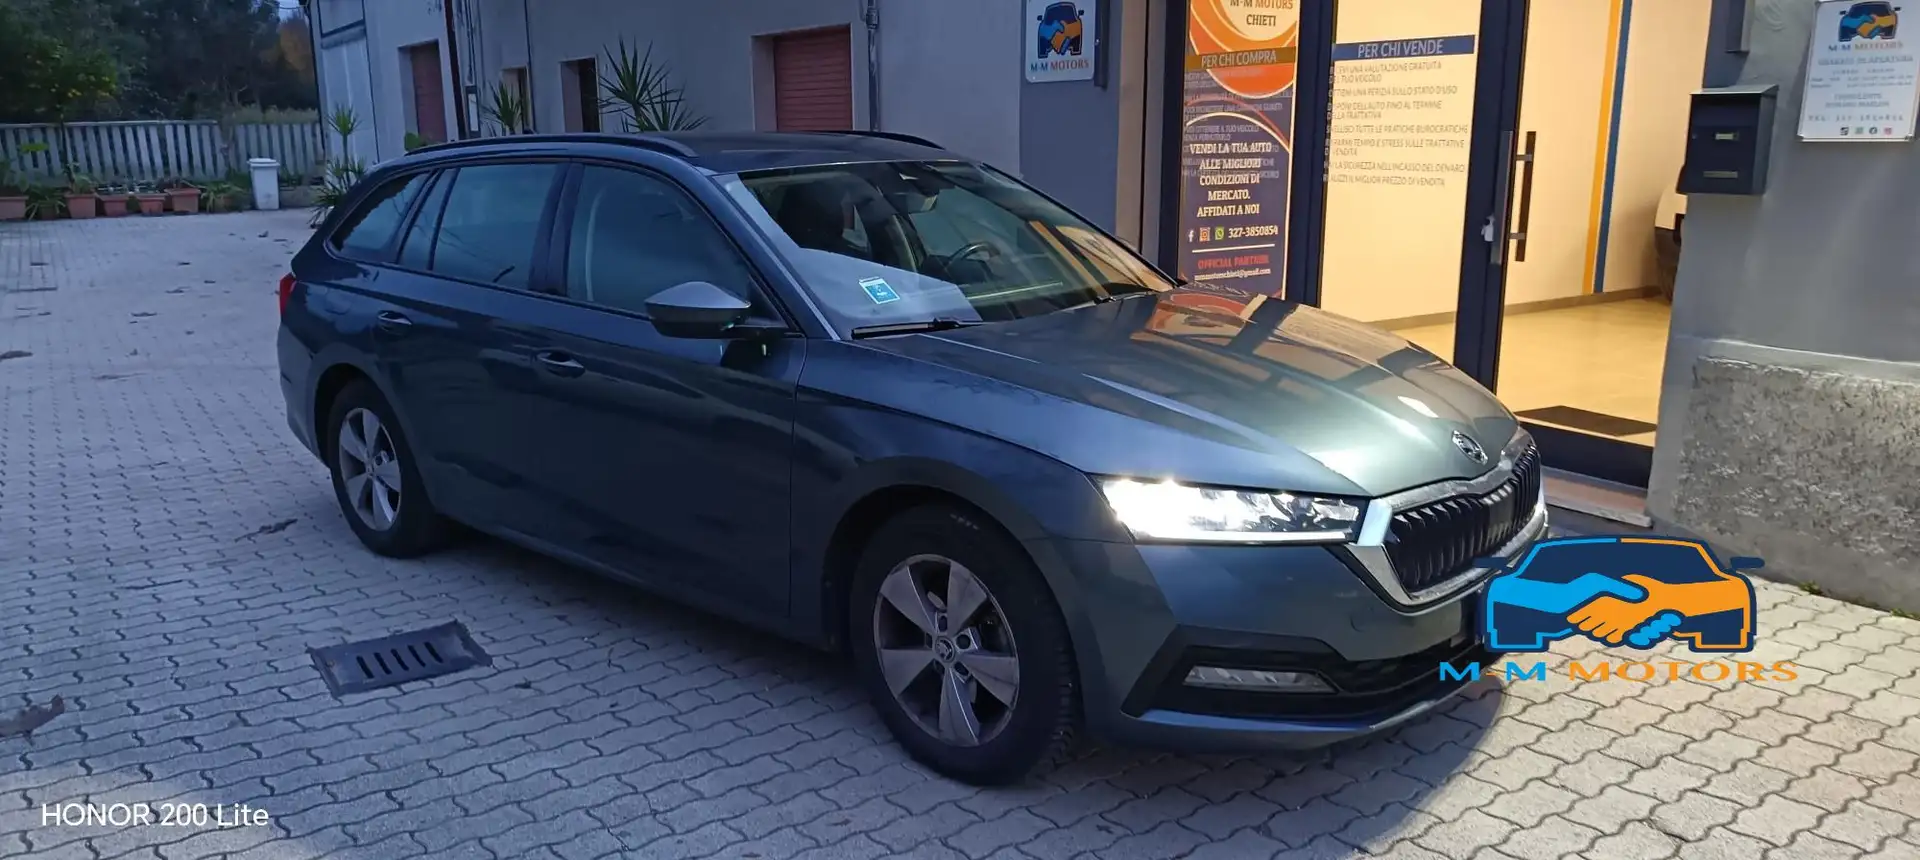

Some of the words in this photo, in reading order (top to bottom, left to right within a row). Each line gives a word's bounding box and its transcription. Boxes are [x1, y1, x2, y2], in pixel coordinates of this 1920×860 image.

[1246, 14, 1276, 26] CHIETI
[1358, 44, 1378, 58] PER
[1381, 42, 1400, 57] CHI
[1403, 39, 1444, 55] VENDE
[1030, 60, 1048, 72] M-M
[1051, 58, 1089, 70] MOTORS
[1202, 54, 1218, 68] PER
[1219, 53, 1234, 66] CHI
[1236, 50, 1277, 65] COMPRA
[1190, 143, 1217, 154] VENDI
[1218, 143, 1229, 154] LA
[1232, 143, 1247, 154] TUA
[1248, 142, 1272, 153] AUTO
[1199, 159, 1221, 170] ALLE
[1222, 158, 1261, 169] MIGLIORI
[1200, 174, 1249, 185] CONDIZIONI
[1251, 174, 1260, 183] DI
[1207, 189, 1250, 201] MERCATO.
[1197, 204, 1236, 217] AFFIDATI
[1236, 205, 1243, 214] A
[1244, 204, 1260, 215] NOI
[1228, 225, 1278, 238] 327-3850854
[1197, 257, 1233, 269] OFFICIAL
